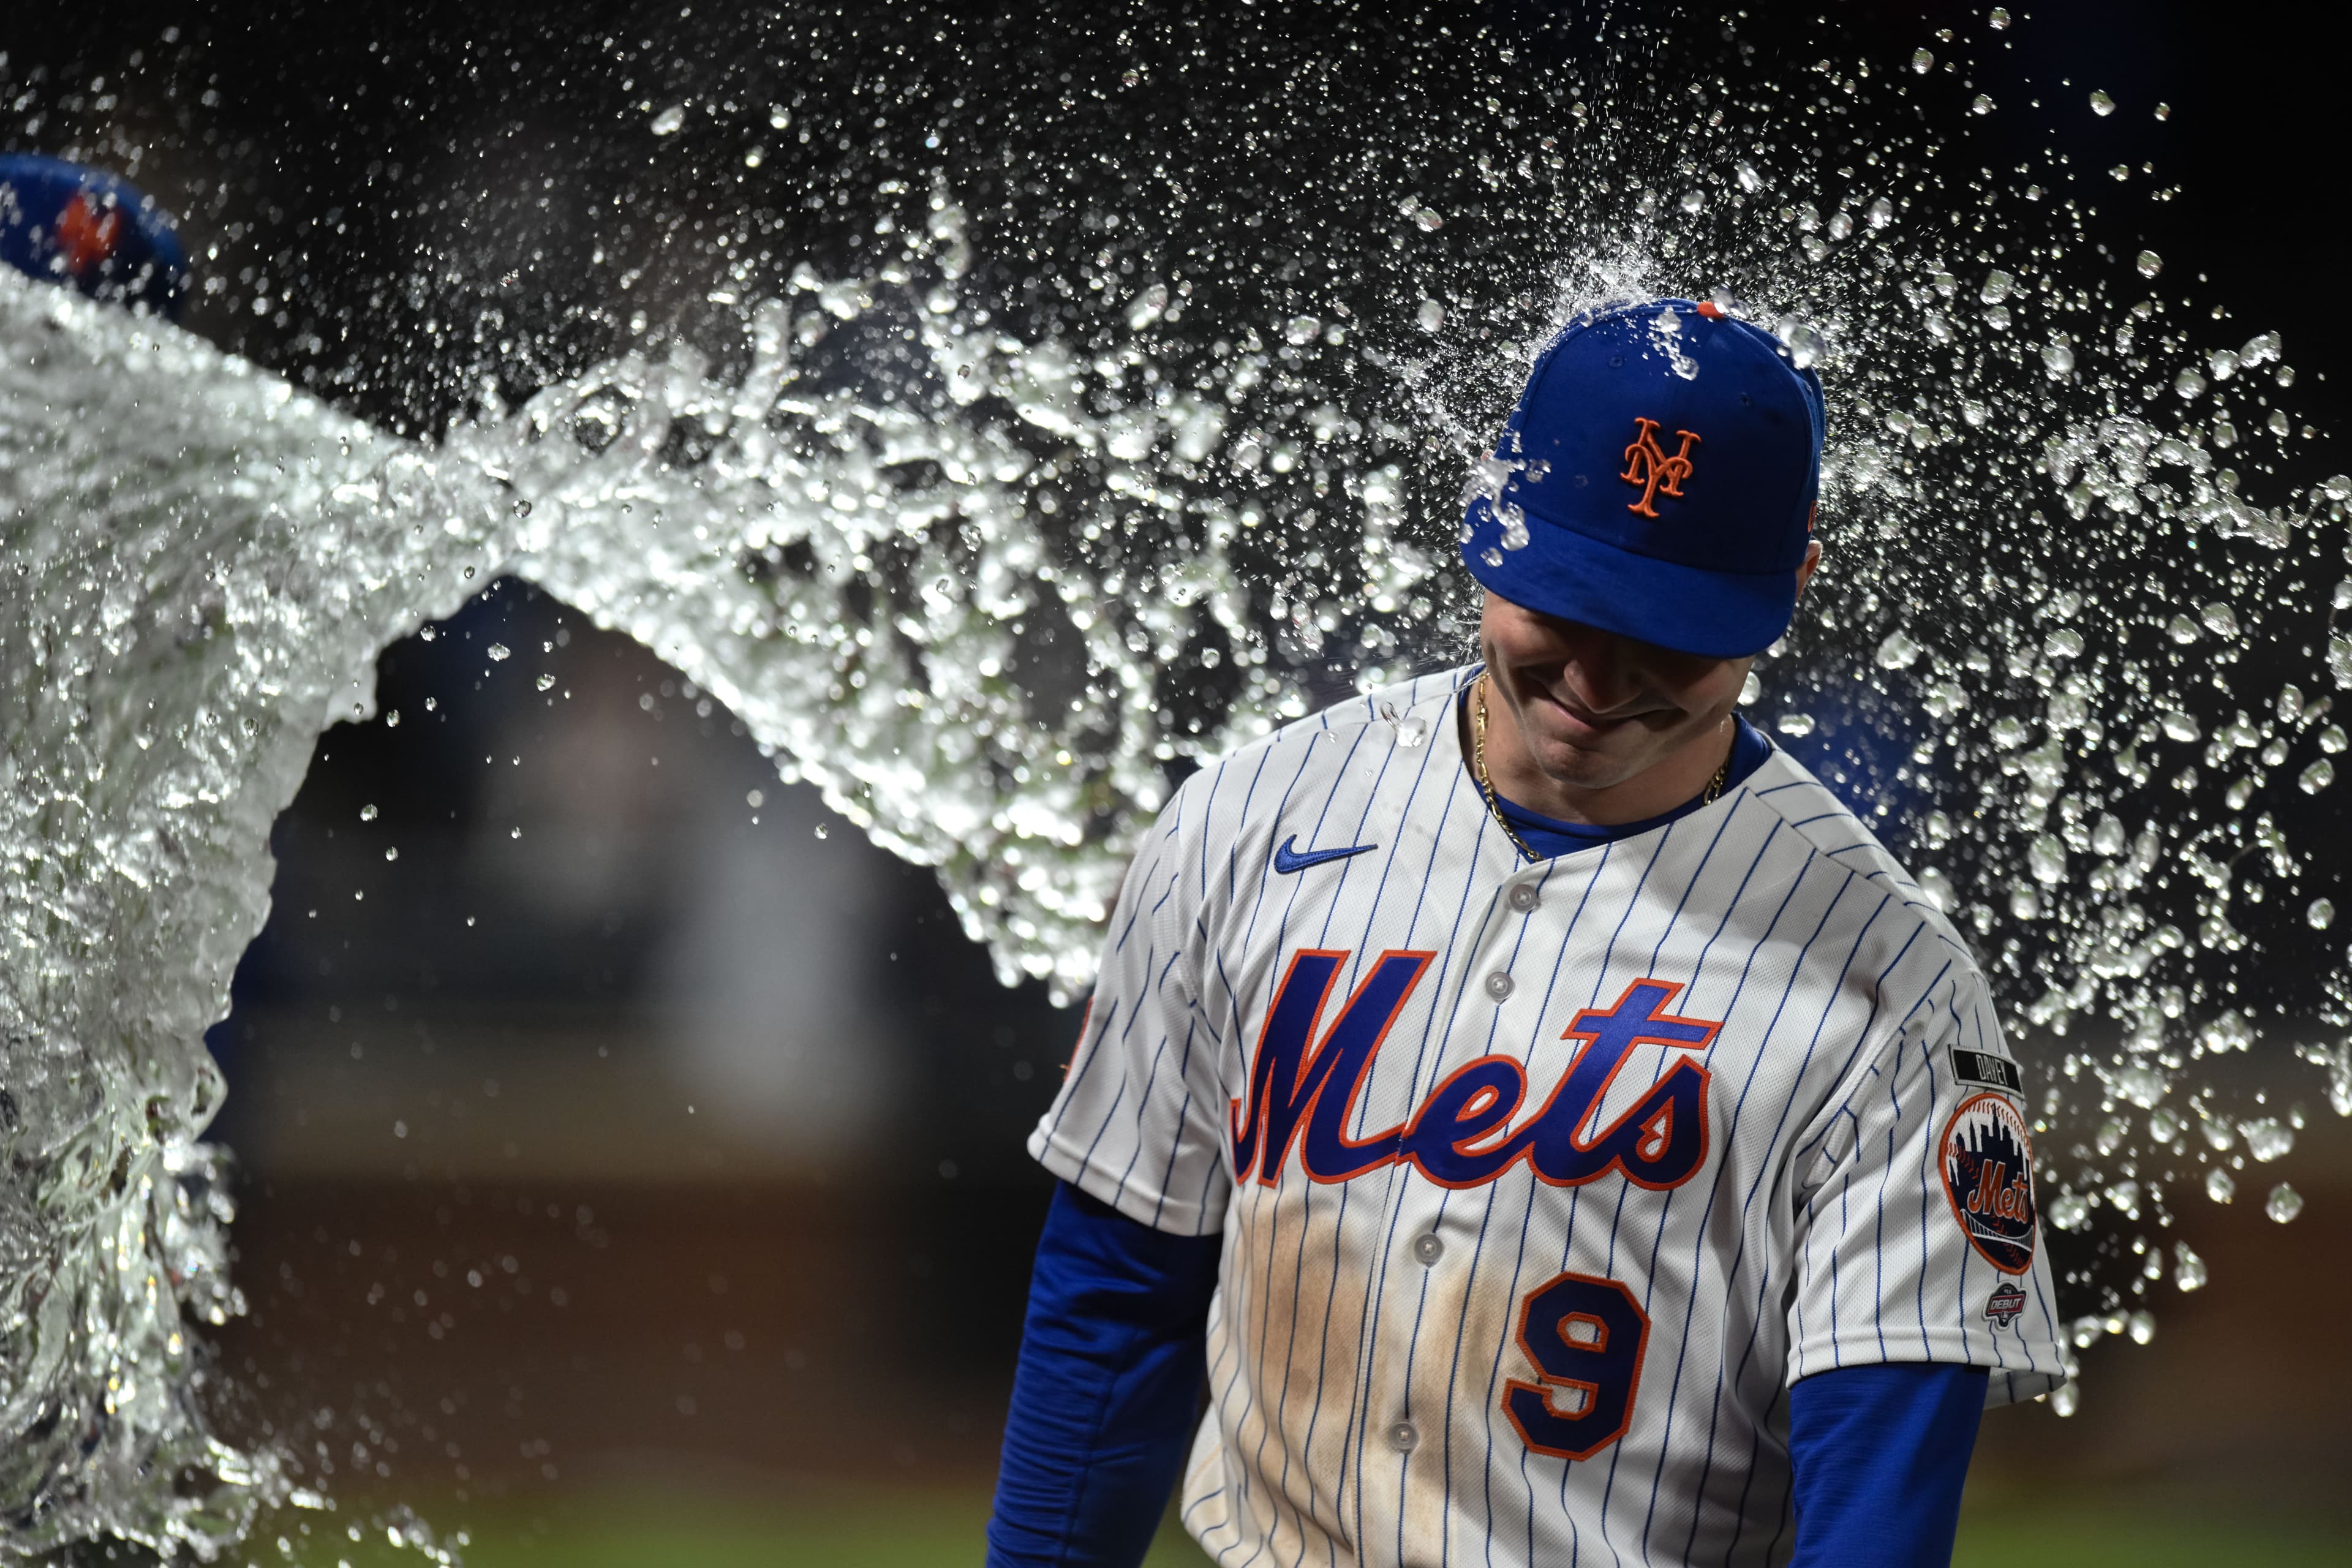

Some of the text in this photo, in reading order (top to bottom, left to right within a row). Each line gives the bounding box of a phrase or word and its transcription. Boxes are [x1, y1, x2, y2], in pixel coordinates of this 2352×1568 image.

[1229, 949, 1724, 1191] Mets
[1975, 1054, 2008, 1086] DAVEY
[1967, 1158, 2029, 1224] Mets
[1990, 1298, 2022, 1310] DEBUT
[1502, 1271, 1651, 1462] 9
